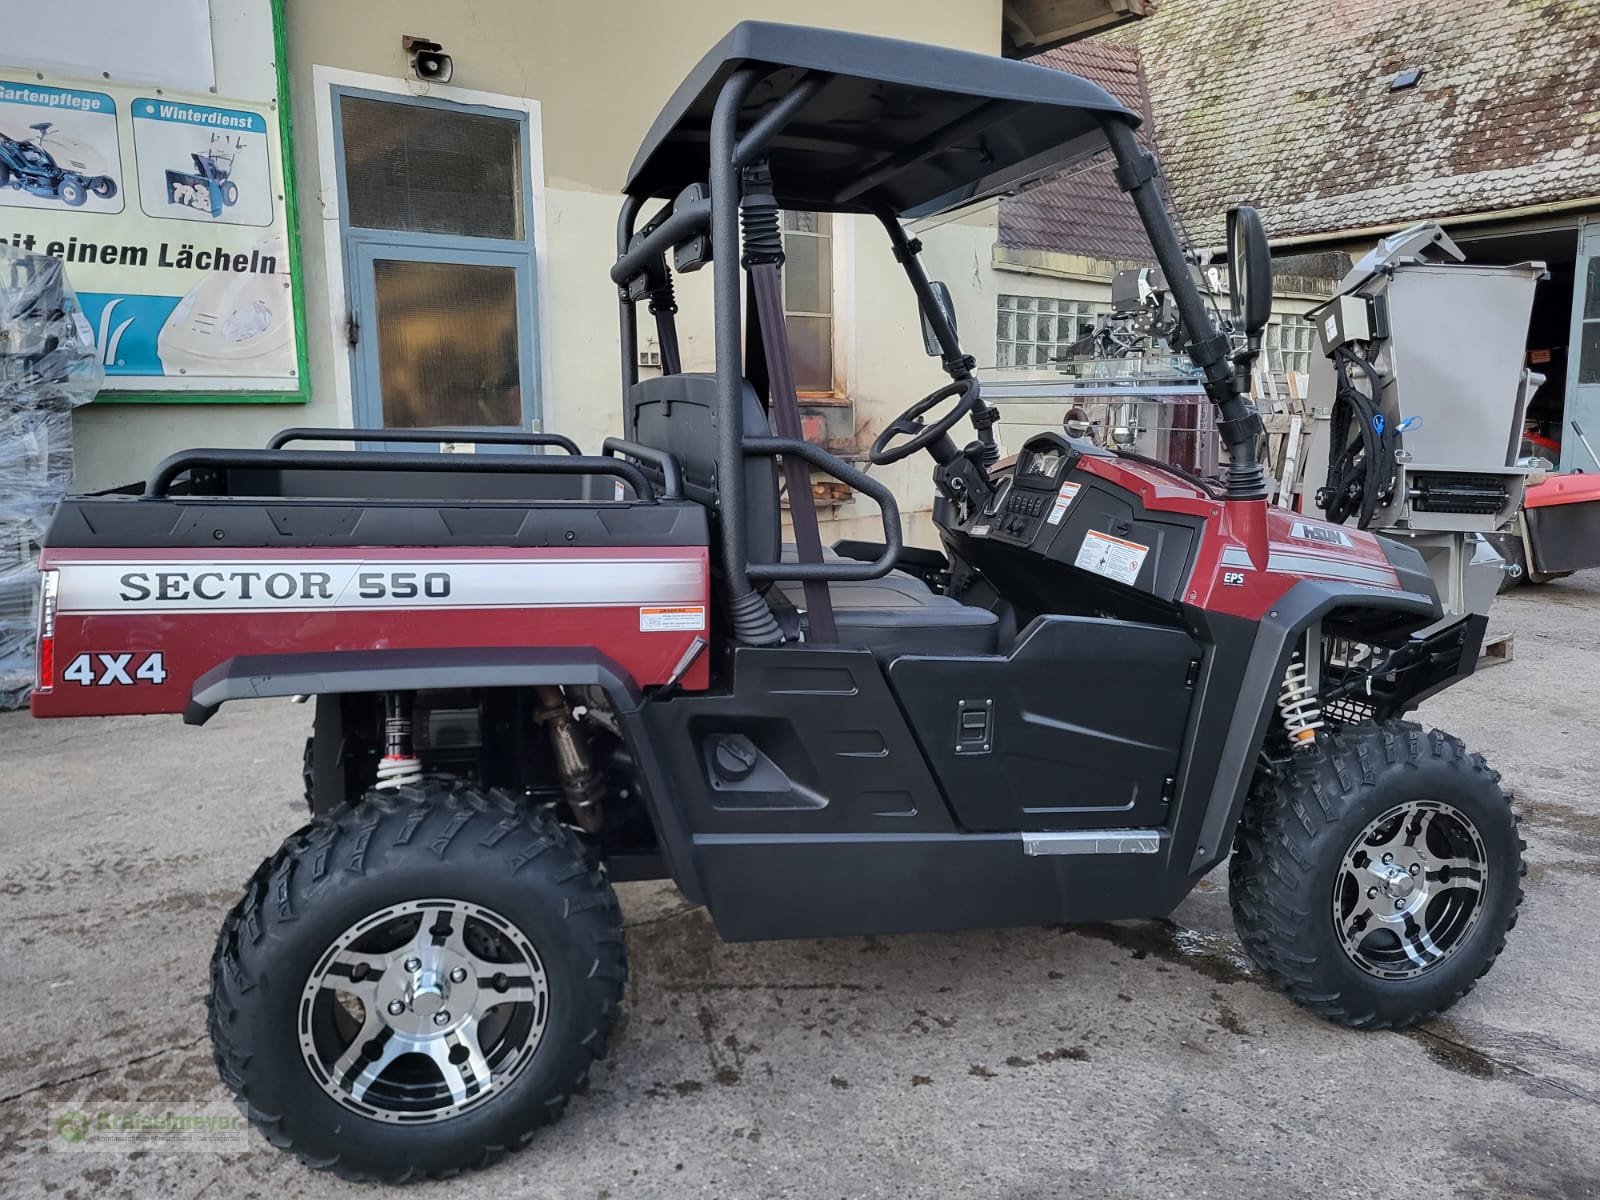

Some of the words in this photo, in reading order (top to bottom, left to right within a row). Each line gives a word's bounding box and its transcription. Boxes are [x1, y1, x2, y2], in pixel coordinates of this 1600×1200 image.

[159, 105, 253, 129] Winterdienst
[46, 237, 148, 266] einem
[158, 242, 277, 274] Lächeln
[119, 572, 334, 601] SECTOR
[358, 572, 451, 599] 550
[1223, 572, 1245, 584] EPS
